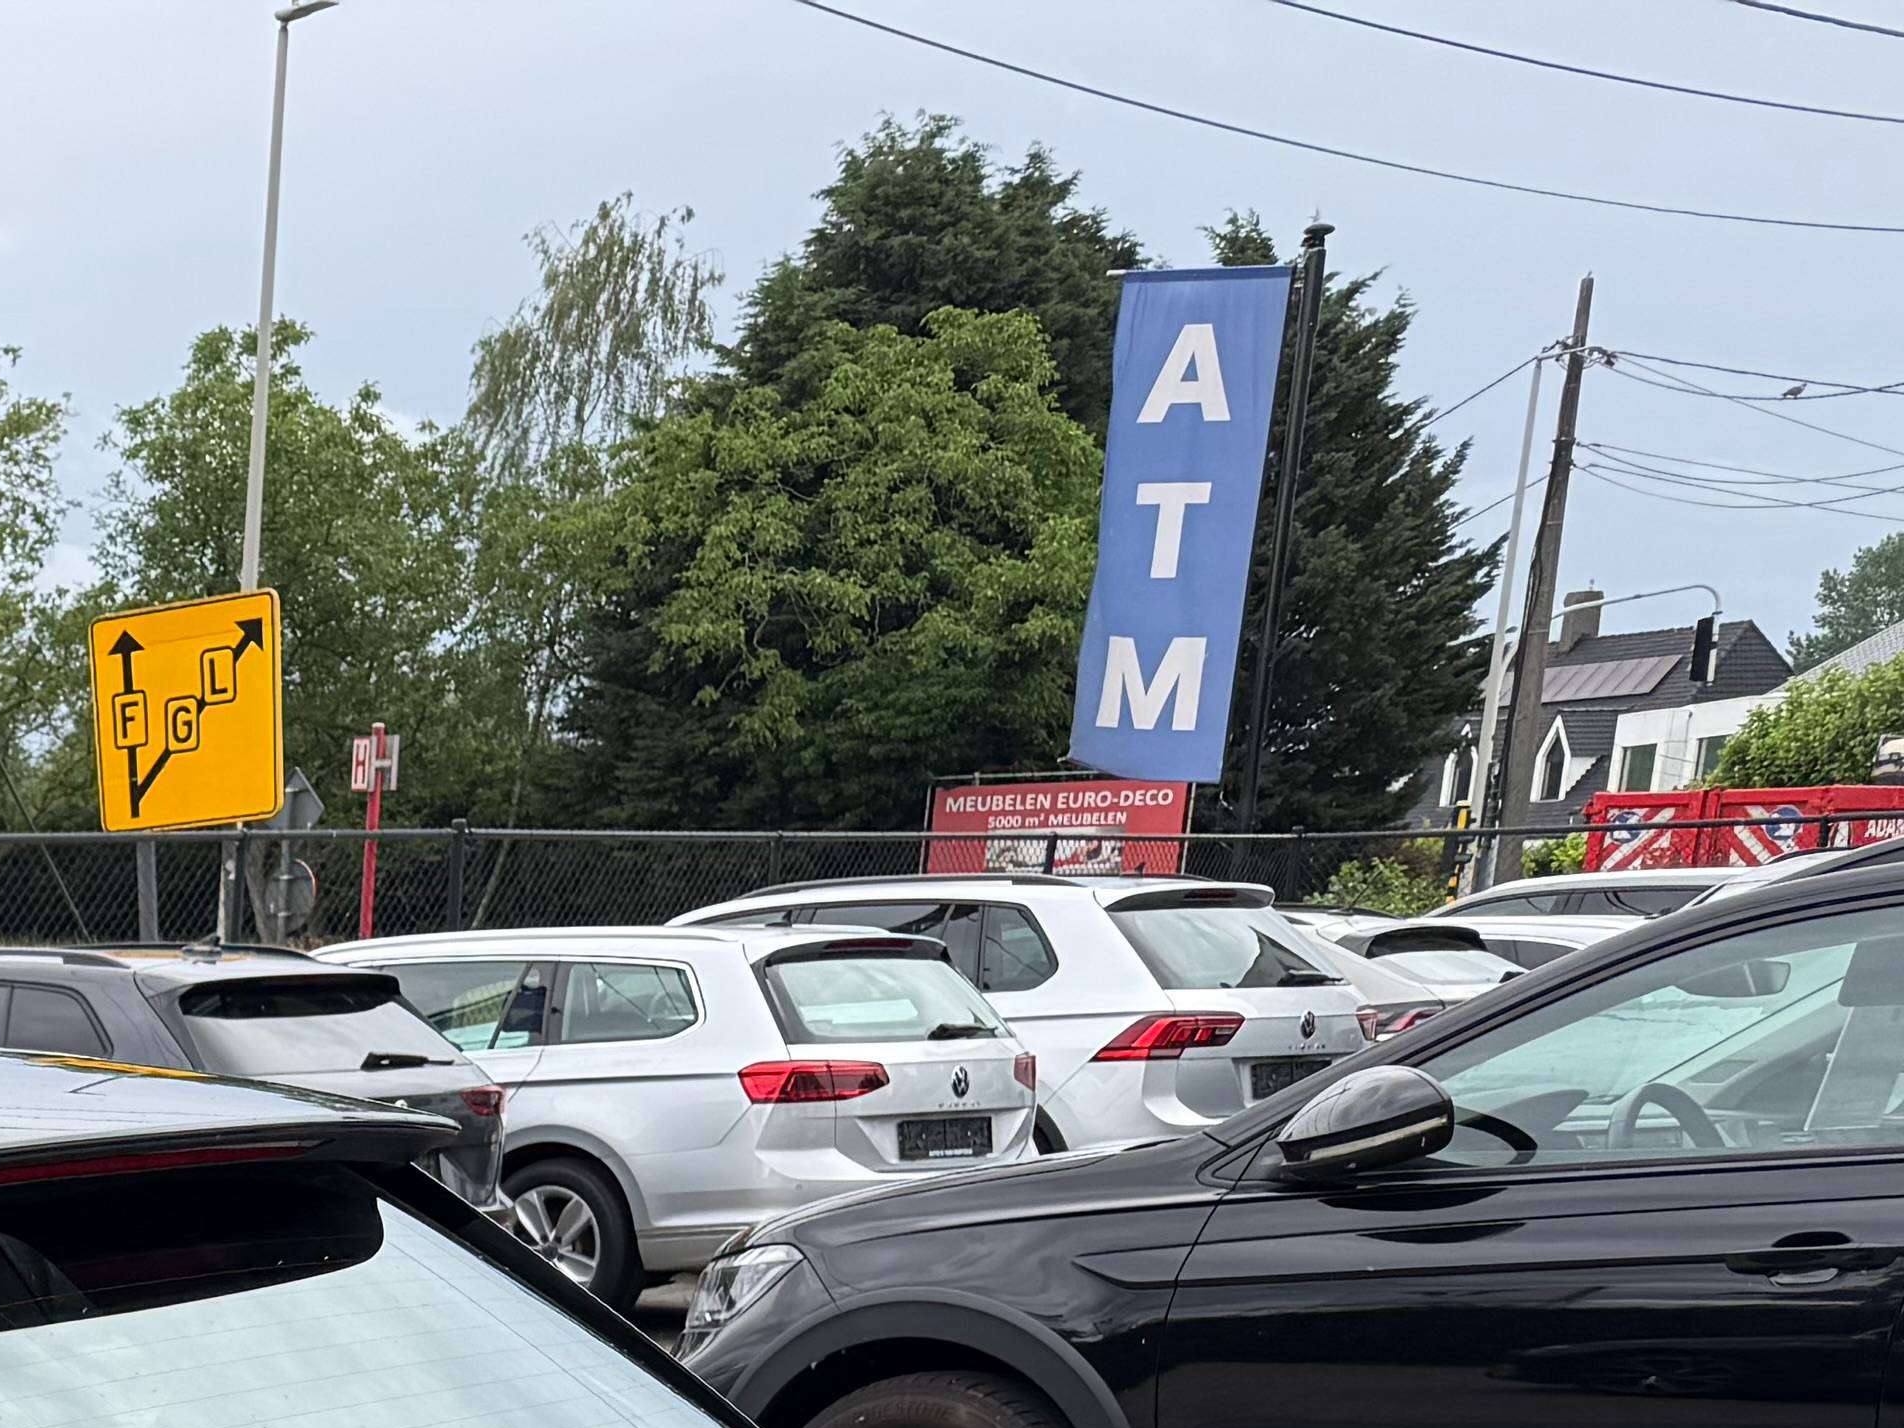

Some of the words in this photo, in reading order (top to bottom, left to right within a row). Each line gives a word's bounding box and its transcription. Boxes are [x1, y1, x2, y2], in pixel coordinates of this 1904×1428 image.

[1095, 324, 1231, 731] ATM
[209, 657, 228, 696] L
[120, 701, 140, 740] F
[171, 705, 193, 744] G
[945, 793, 1052, 813] MEUBELEN
[1056, 788, 1175, 810] EURO-DECO
[987, 815, 1022, 829] 5000
[1048, 811, 1128, 826] MEUBELEN
